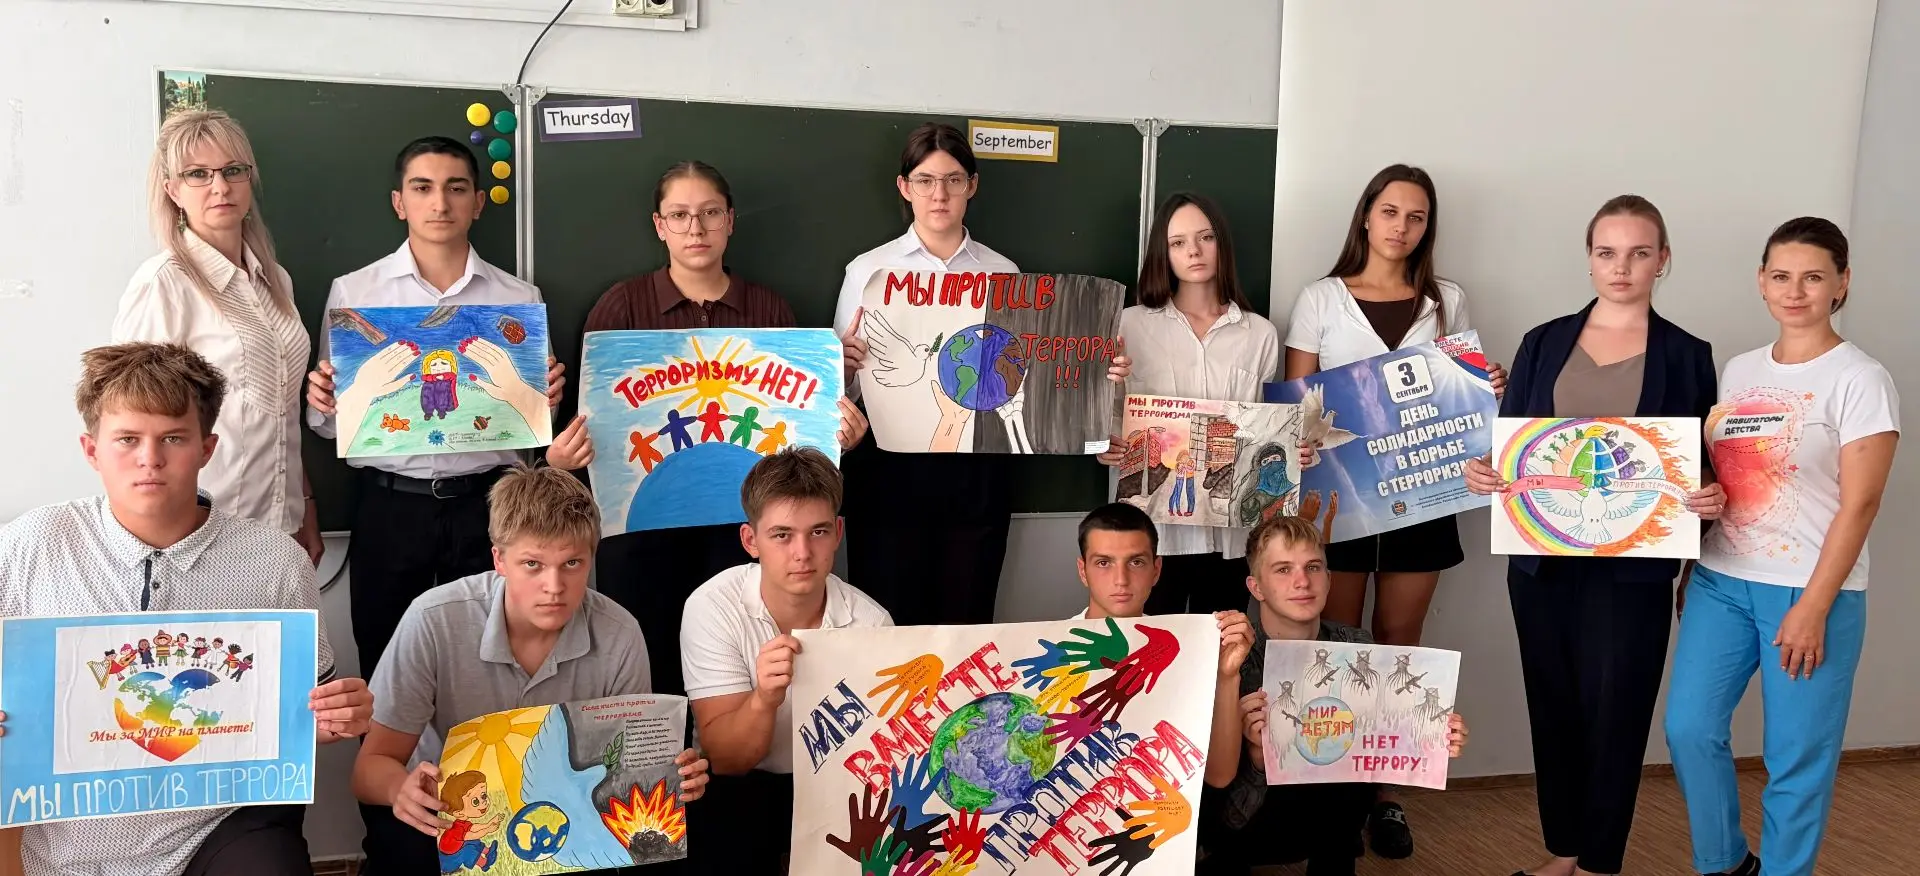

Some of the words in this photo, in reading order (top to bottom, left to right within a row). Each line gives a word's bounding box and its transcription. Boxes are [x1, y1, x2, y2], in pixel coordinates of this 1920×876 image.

[546, 107, 630, 128] Thursday
[974, 132, 1052, 151] September
[938, 271, 1056, 311] ПРОТИВ
[758, 360, 818, 409] НЕТ!
[1397, 362, 1417, 387] 3
[1395, 385, 1429, 399] СЕНТЯБРЯ
[1127, 397, 1147, 407] МЫ
[1151, 398, 1196, 410] ПРОТИВ
[1129, 409, 1191, 419] ТЕРРОРИЗМА
[1400, 403, 1440, 428] ДЕНЬ
[1725, 415, 1785, 426] НАВИГАТОРЫ
[1366, 412, 1485, 456] СОЛИДАРНОСТИ
[1724, 424, 1761, 436] ДЕТСТВА
[1395, 454, 1408, 470] В
[1408, 438, 1467, 468] БОРЬБЕ
[1377, 481, 1389, 497] С
[1389, 457, 1480, 494] ТЕРРОРИЗ
[1526, 478, 1544, 487] МЫ
[1612, 480, 1646, 489] ПРОТИВ
[843, 641, 1021, 799] ВМЕСТЕ
[1308, 705, 1338, 720] МИР
[89, 730, 117, 743] Мы
[120, 732, 135, 741] за
[137, 725, 176, 740] МИР
[178, 728, 194, 737] на
[197, 721, 255, 736] планете!
[799, 677, 873, 775] МЫ
[1300, 720, 1354, 738] ДЕТЯМ
[1362, 735, 1400, 750] НЕТ
[1352, 755, 1428, 772] ТЕРРОРУ!
[7, 782, 61, 824] МЫ
[72, 771, 189, 816] ПРОТИВ
[196, 762, 308, 805] ТЕРРОРА
[983, 719, 1141, 876] ПРОТИВ
[1028, 719, 1206, 876] ТЕРРОРА
